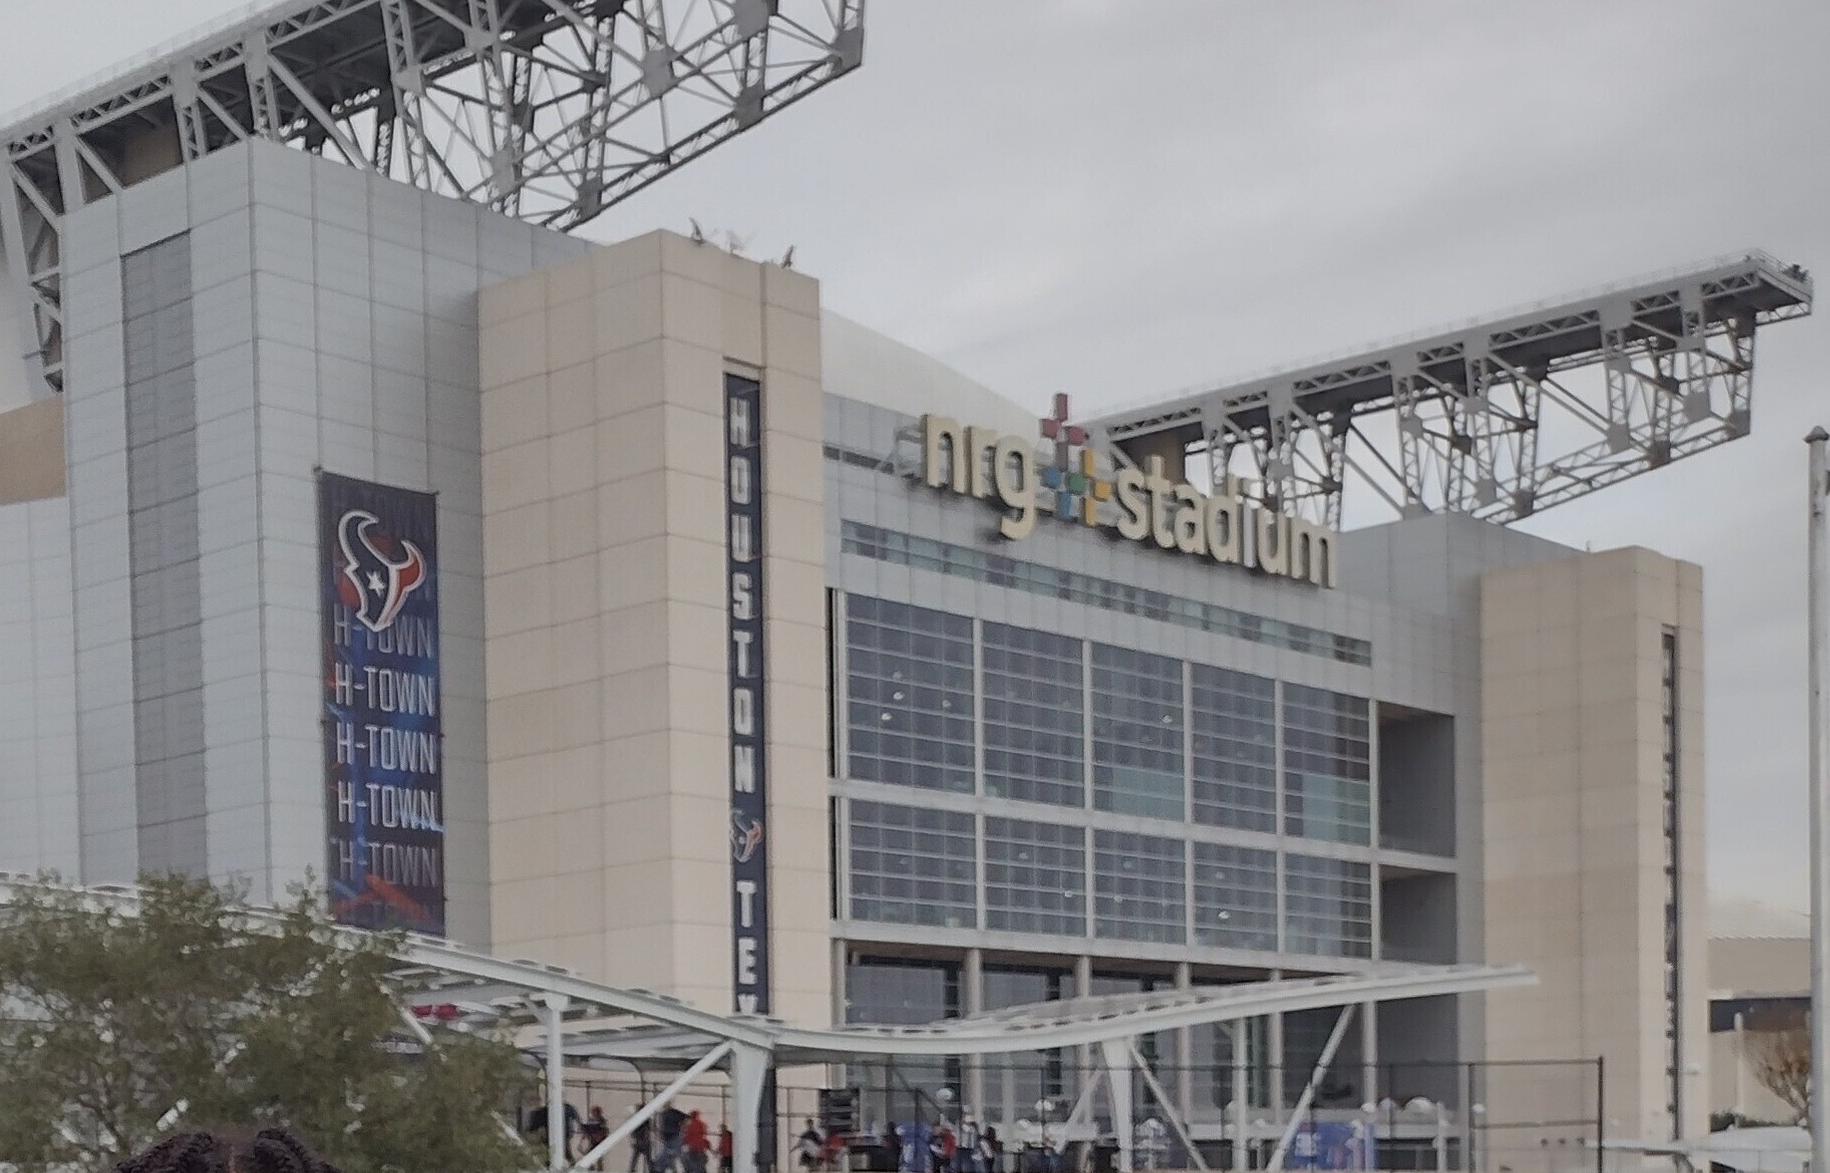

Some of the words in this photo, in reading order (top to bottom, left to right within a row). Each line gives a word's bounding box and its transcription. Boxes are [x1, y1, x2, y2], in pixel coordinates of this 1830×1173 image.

[921, 414, 1038, 540] nrg
[1114, 454, 1338, 589] stadium
[730, 397, 757, 794] HOUSTON
[335, 661, 437, 717] H-TOWN
[336, 720, 438, 775] H-TOWN
[337, 780, 440, 830] H-TOWN
[339, 840, 439, 887] H-TOWN
